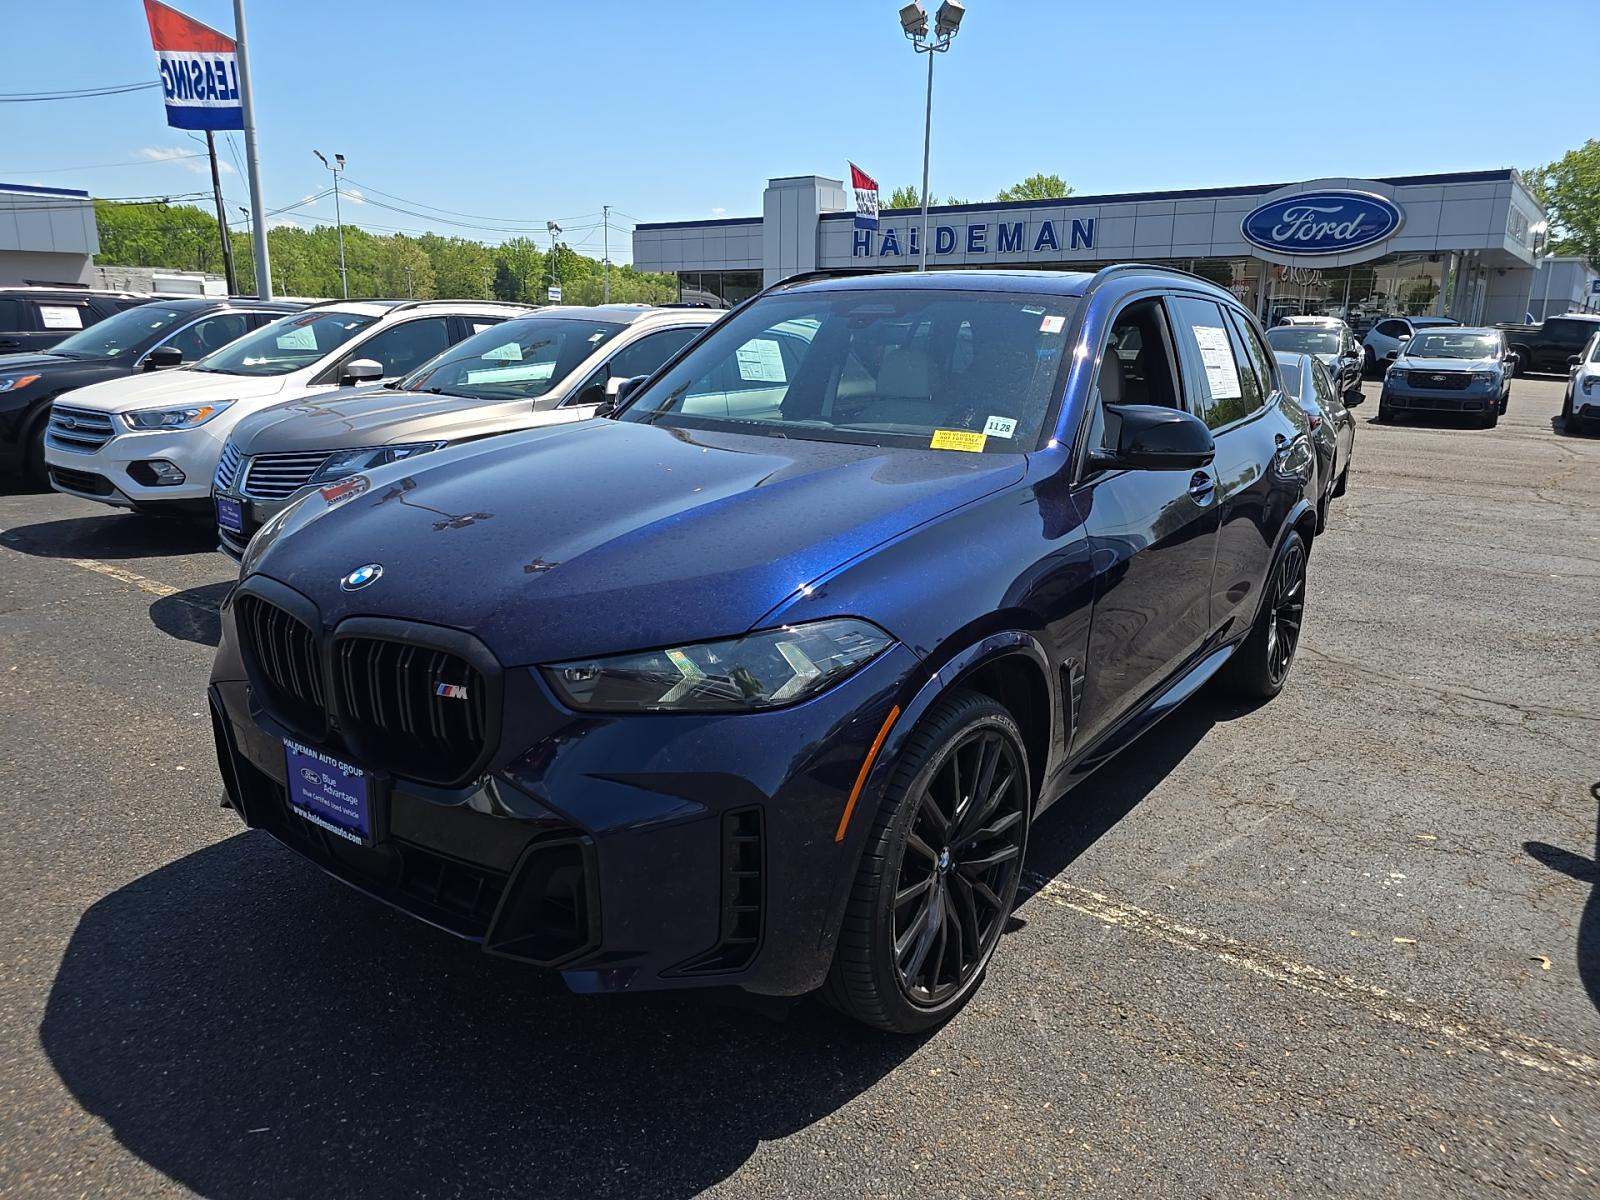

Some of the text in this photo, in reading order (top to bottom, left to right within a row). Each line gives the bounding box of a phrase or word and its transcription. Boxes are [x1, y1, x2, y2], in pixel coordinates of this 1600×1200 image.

[1272, 205, 1366, 242] Ford
[852, 217, 1095, 257] HALDEMAN
[988, 421, 1011, 433] 1128
[450, 685, 468, 699] M
[319, 753, 337, 767] AUTO
[338, 761, 364, 777] GROUP
[322, 773, 337, 788] Blue
[323, 784, 359, 806] Advantage
